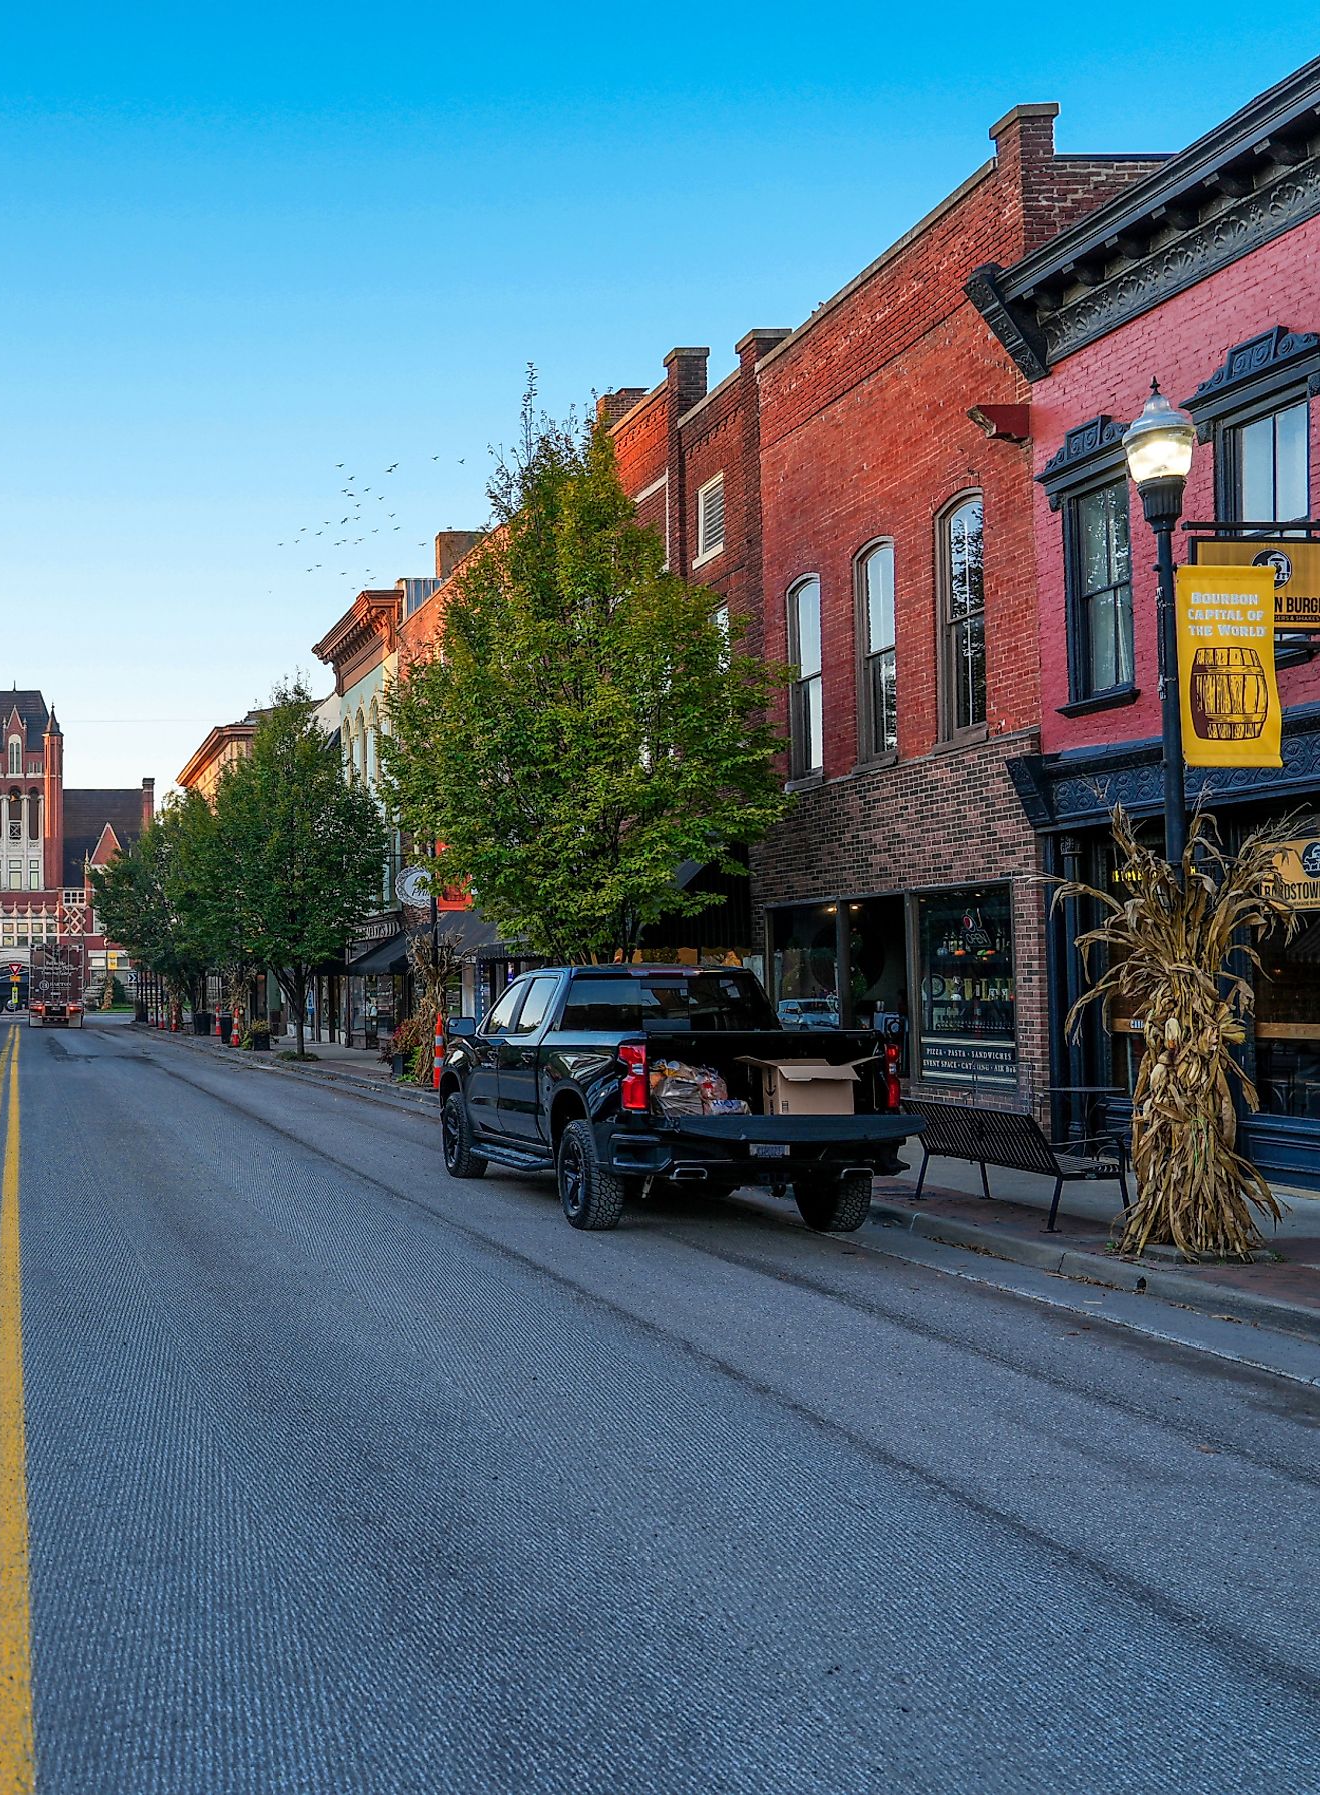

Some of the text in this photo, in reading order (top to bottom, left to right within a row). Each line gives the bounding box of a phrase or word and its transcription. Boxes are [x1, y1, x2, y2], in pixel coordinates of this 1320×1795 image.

[1191, 592, 1259, 605] BOURBON
[1286, 597, 1320, 613] BURG
[1188, 609, 1265, 620] CAPITAL OF
[1189, 624, 1267, 637] THE WORLD
[926, 1047, 1012, 1060] PIZZA PASTA SANDWICHES
[923, 1059, 940, 1067] EVENT
[940, 1060, 957, 1069] SPACE
